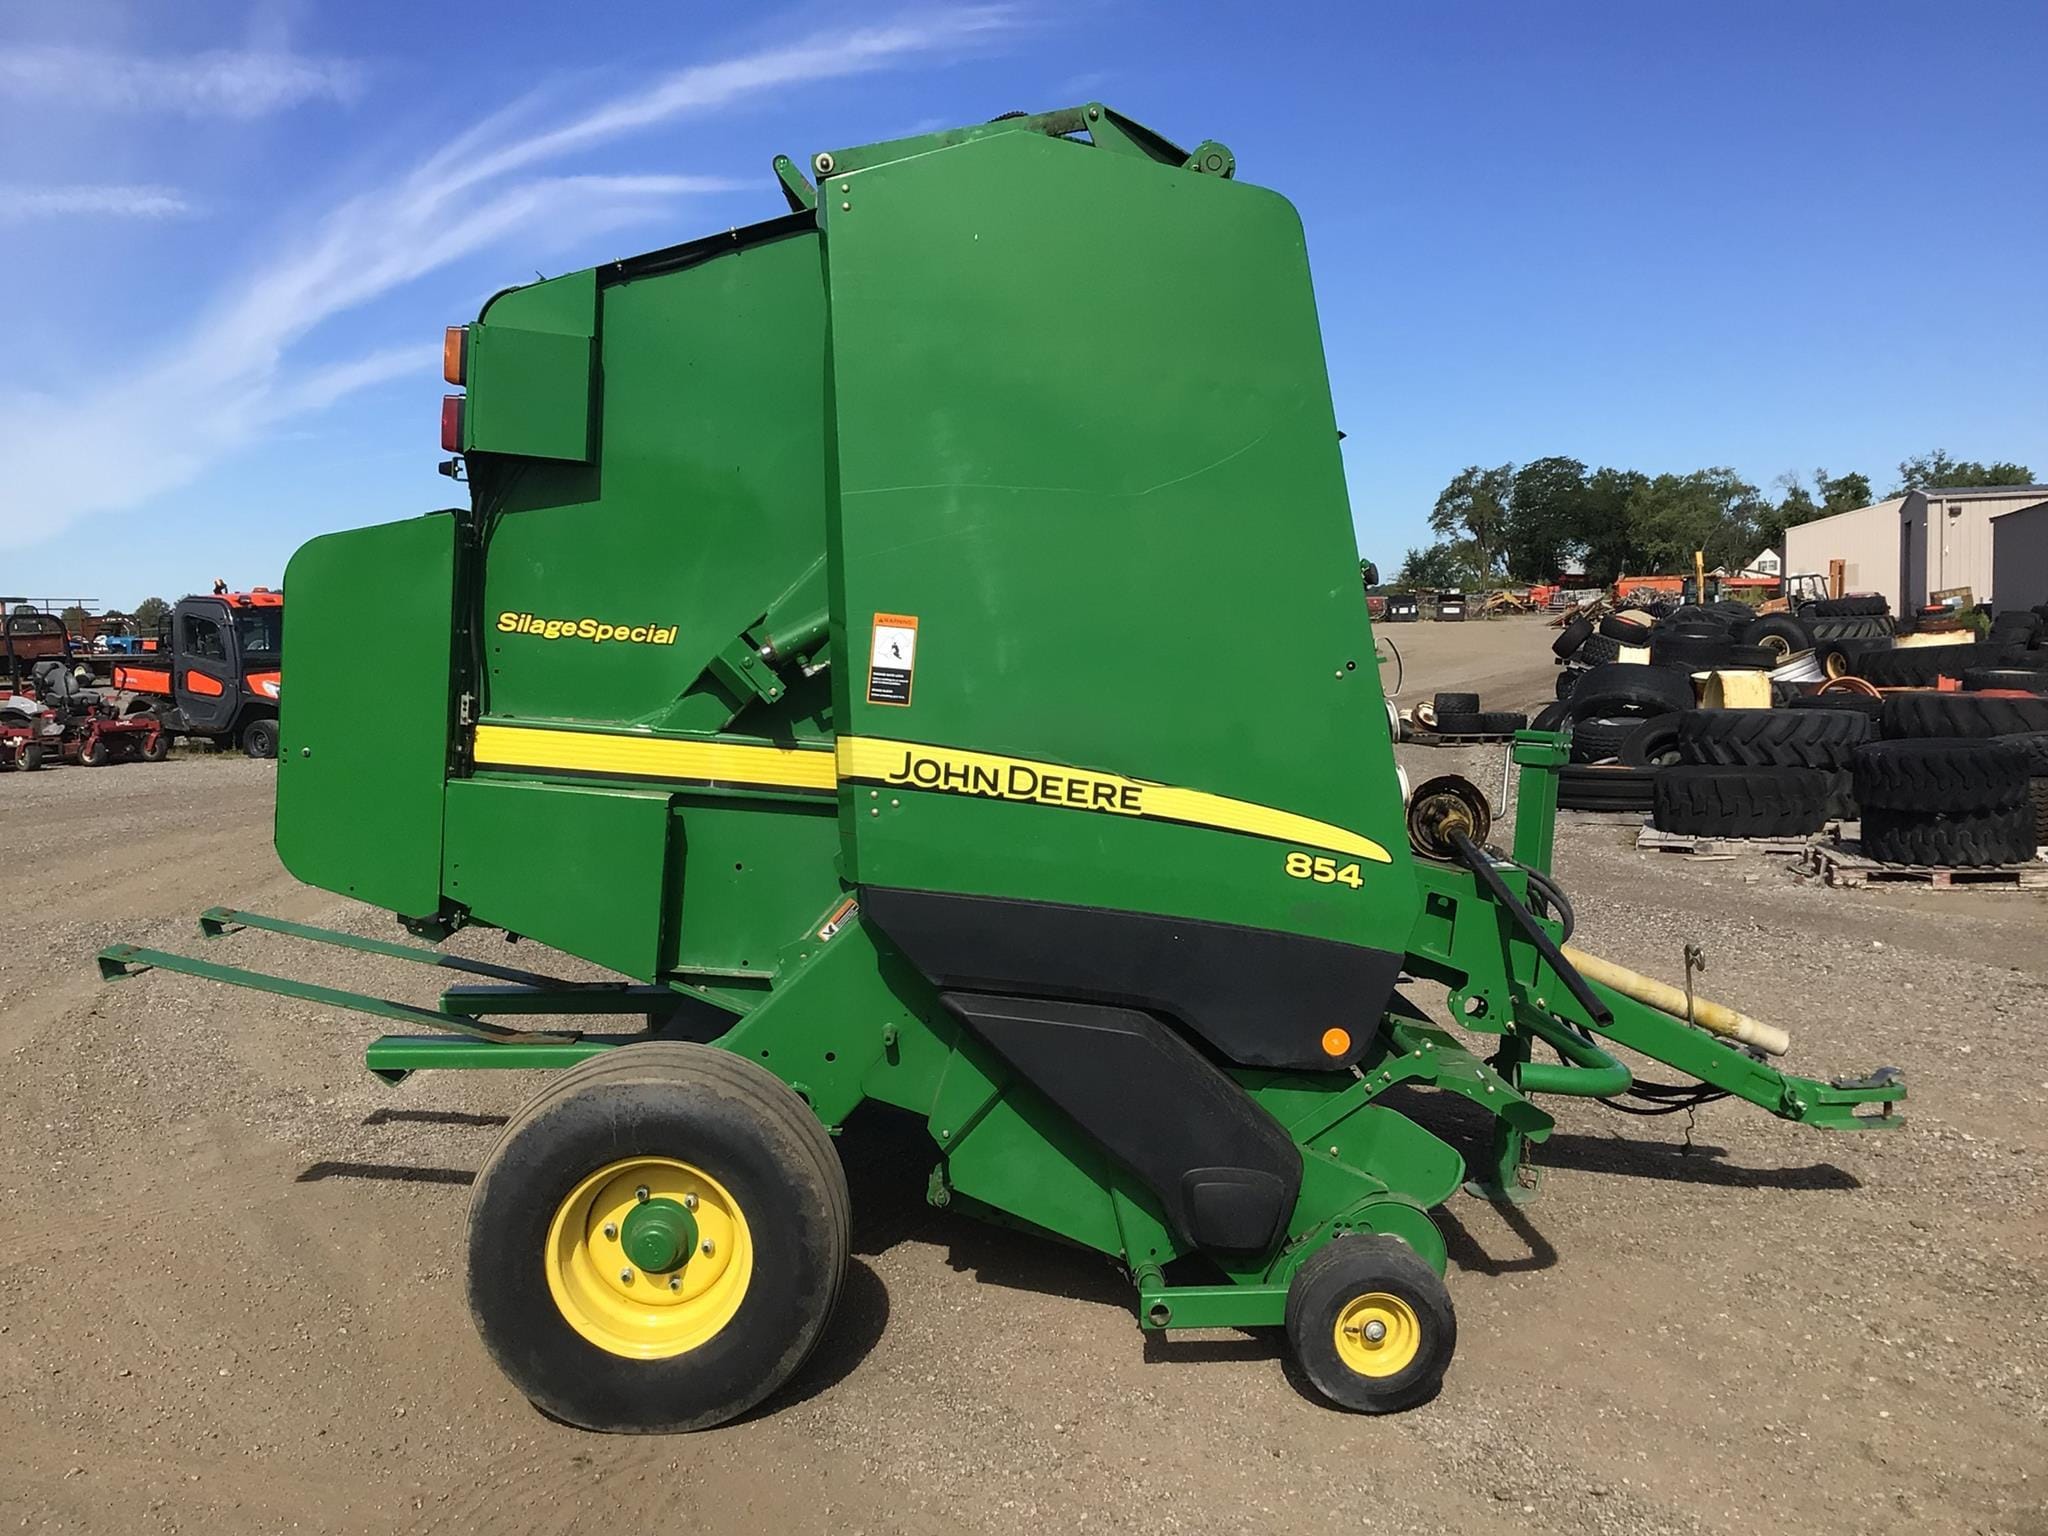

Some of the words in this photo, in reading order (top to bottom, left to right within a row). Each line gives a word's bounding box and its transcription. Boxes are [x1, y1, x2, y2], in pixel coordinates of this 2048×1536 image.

[497, 612, 679, 645] SilageSpecial
[889, 751, 999, 793] JOHN
[1008, 765, 1144, 811] DEERE
[1285, 852, 1365, 889] 854
